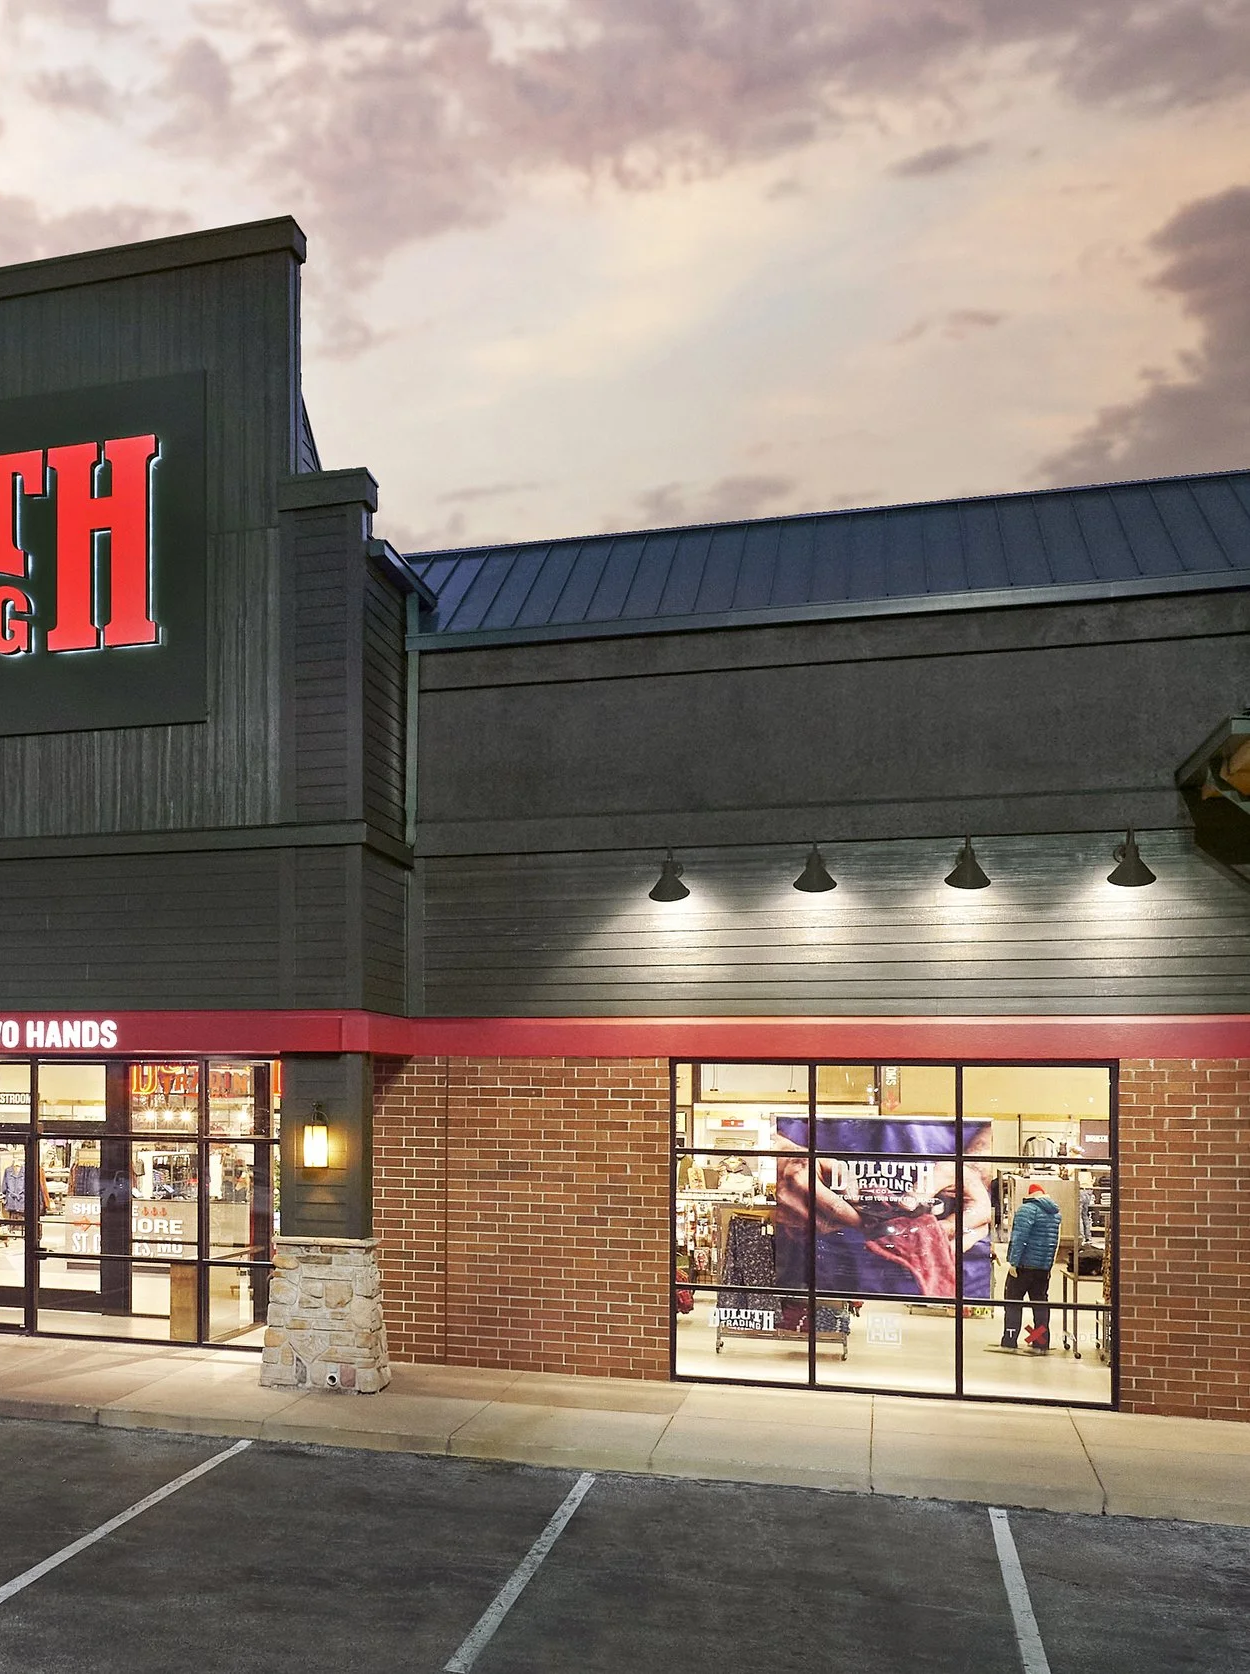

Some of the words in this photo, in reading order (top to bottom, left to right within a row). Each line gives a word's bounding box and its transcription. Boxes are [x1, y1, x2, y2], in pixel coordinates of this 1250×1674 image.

[26, 1020, 118, 1048] HANDS
[831, 1160, 935, 1193] DULUTH
[851, 1178, 914, 1193] RADING
[72, 1203, 101, 1216] SHO
[707, 1307, 777, 1331] DULUTH
